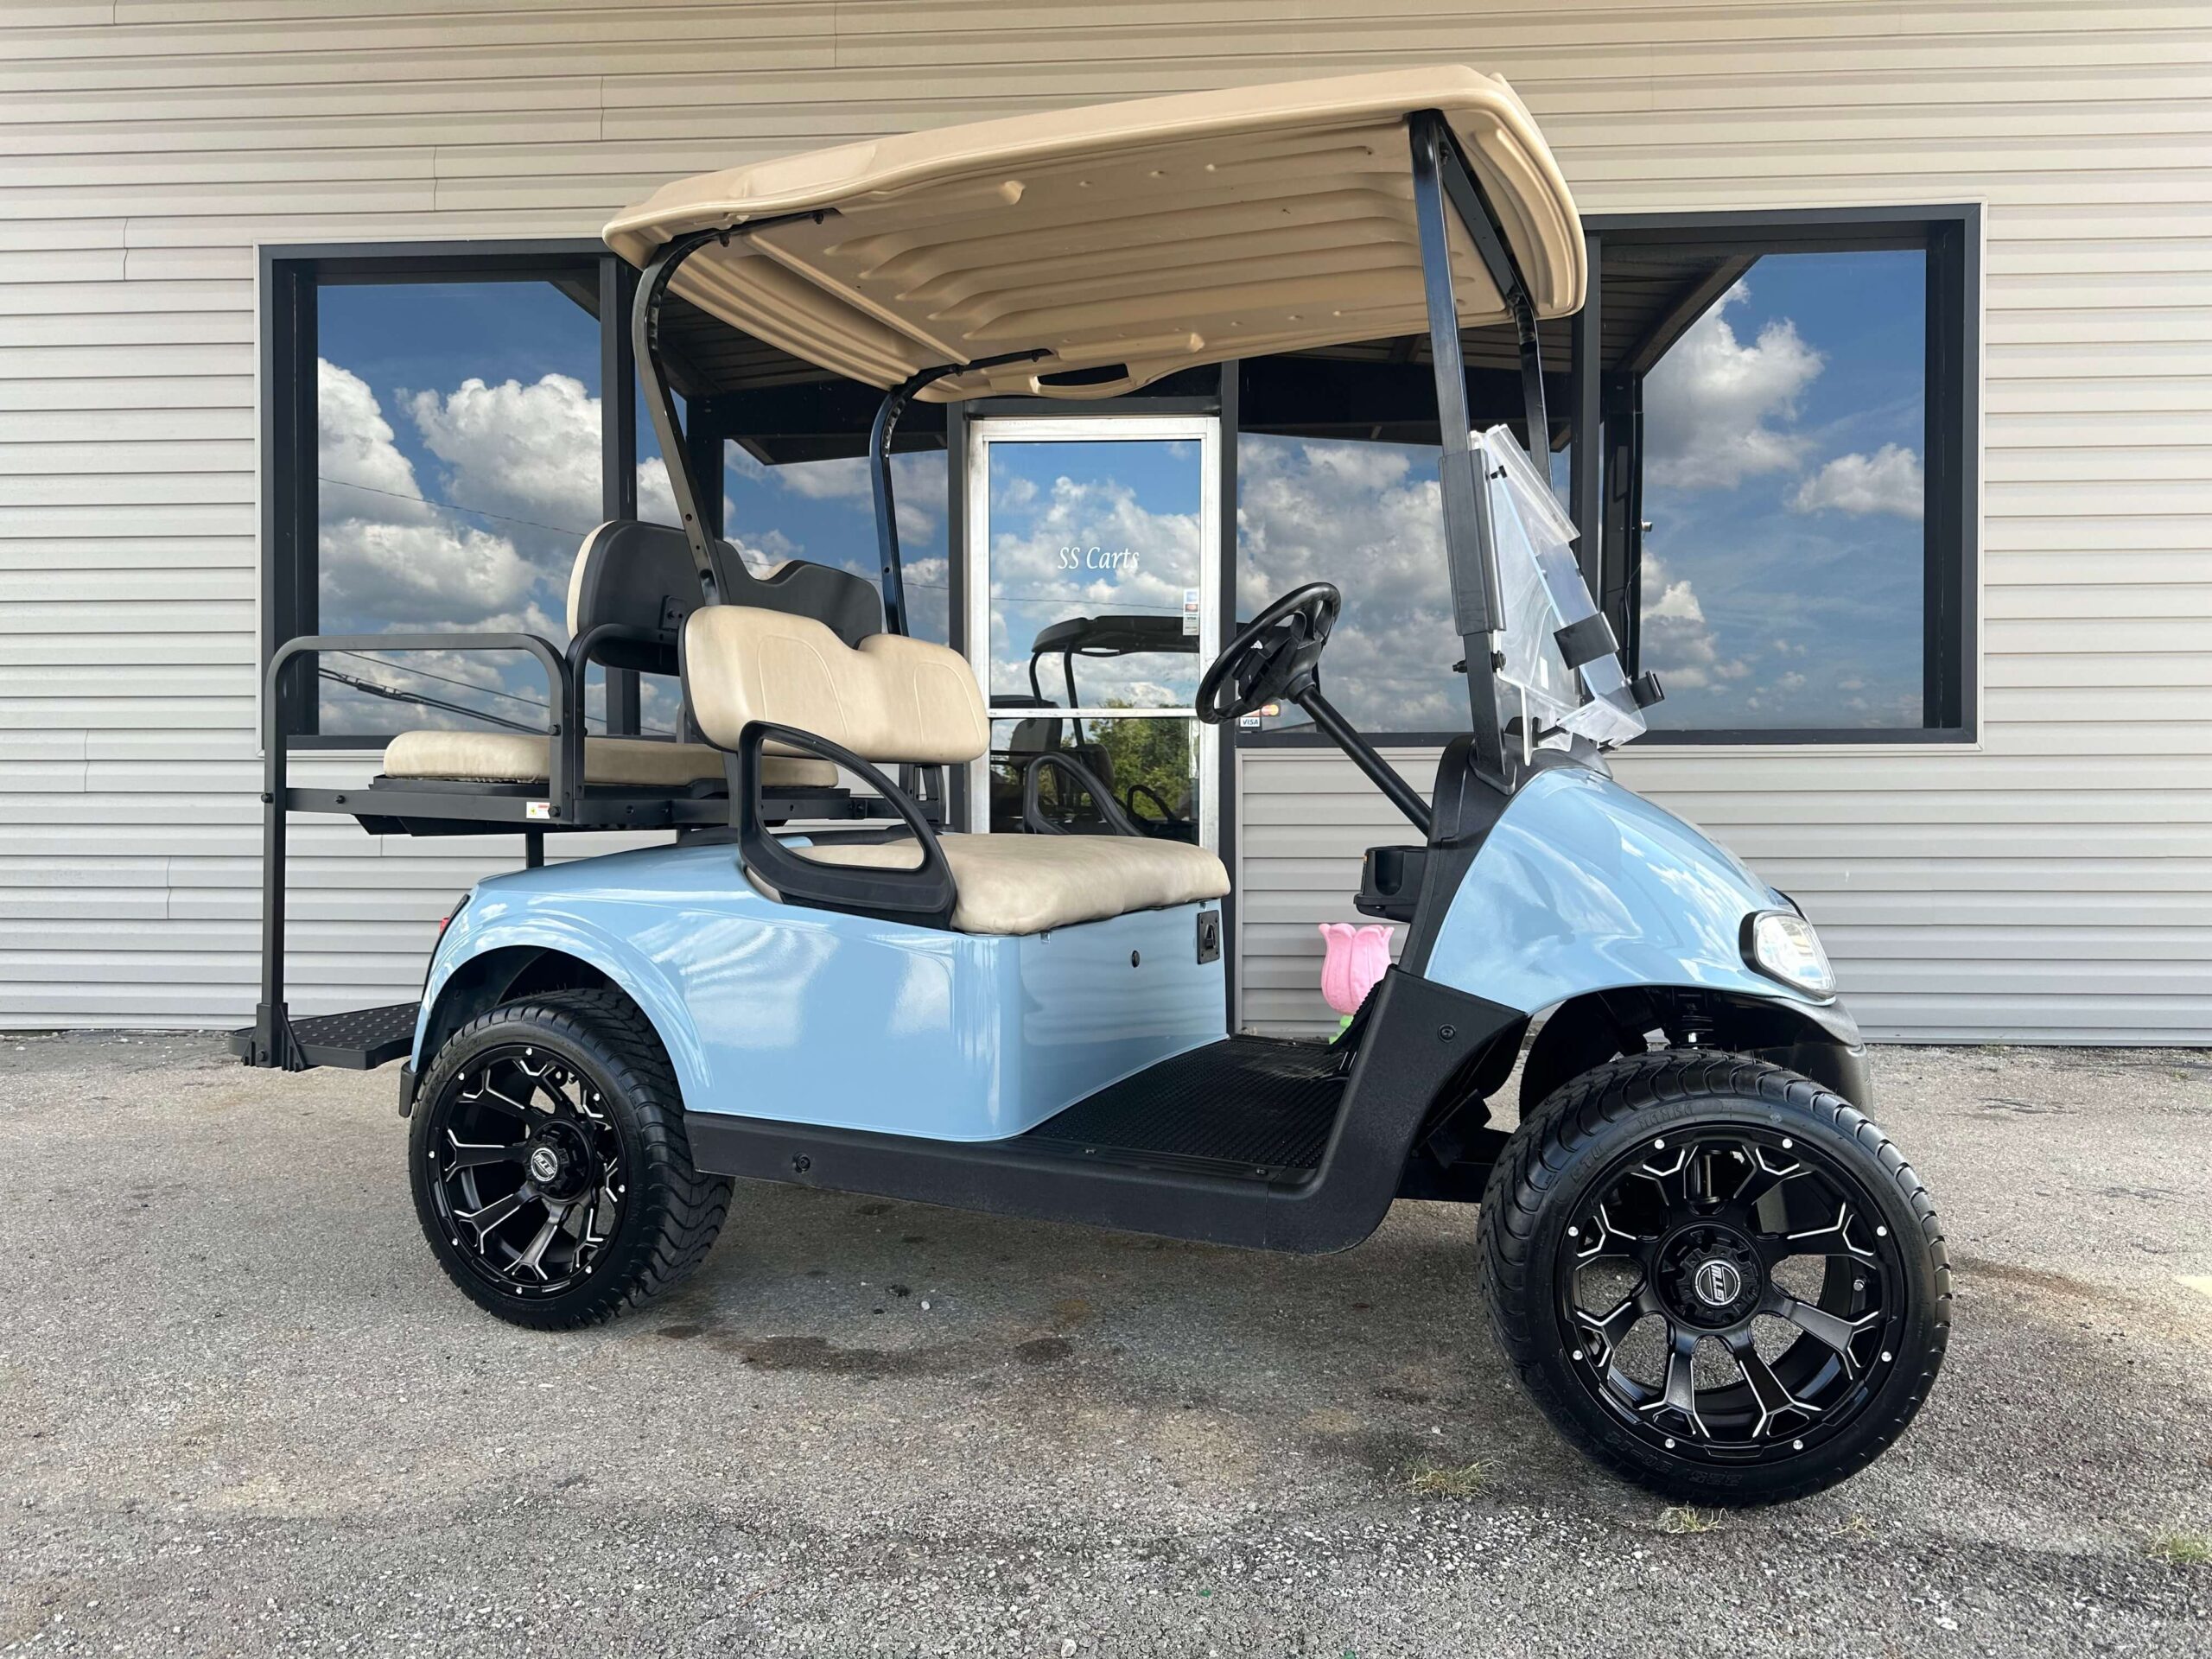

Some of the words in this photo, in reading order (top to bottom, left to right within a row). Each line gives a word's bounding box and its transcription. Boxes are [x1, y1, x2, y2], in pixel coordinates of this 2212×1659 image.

[1057, 546, 1080, 569] SS
[1086, 546, 1140, 569] Carts
[1710, 1263, 1726, 1302] GTW
